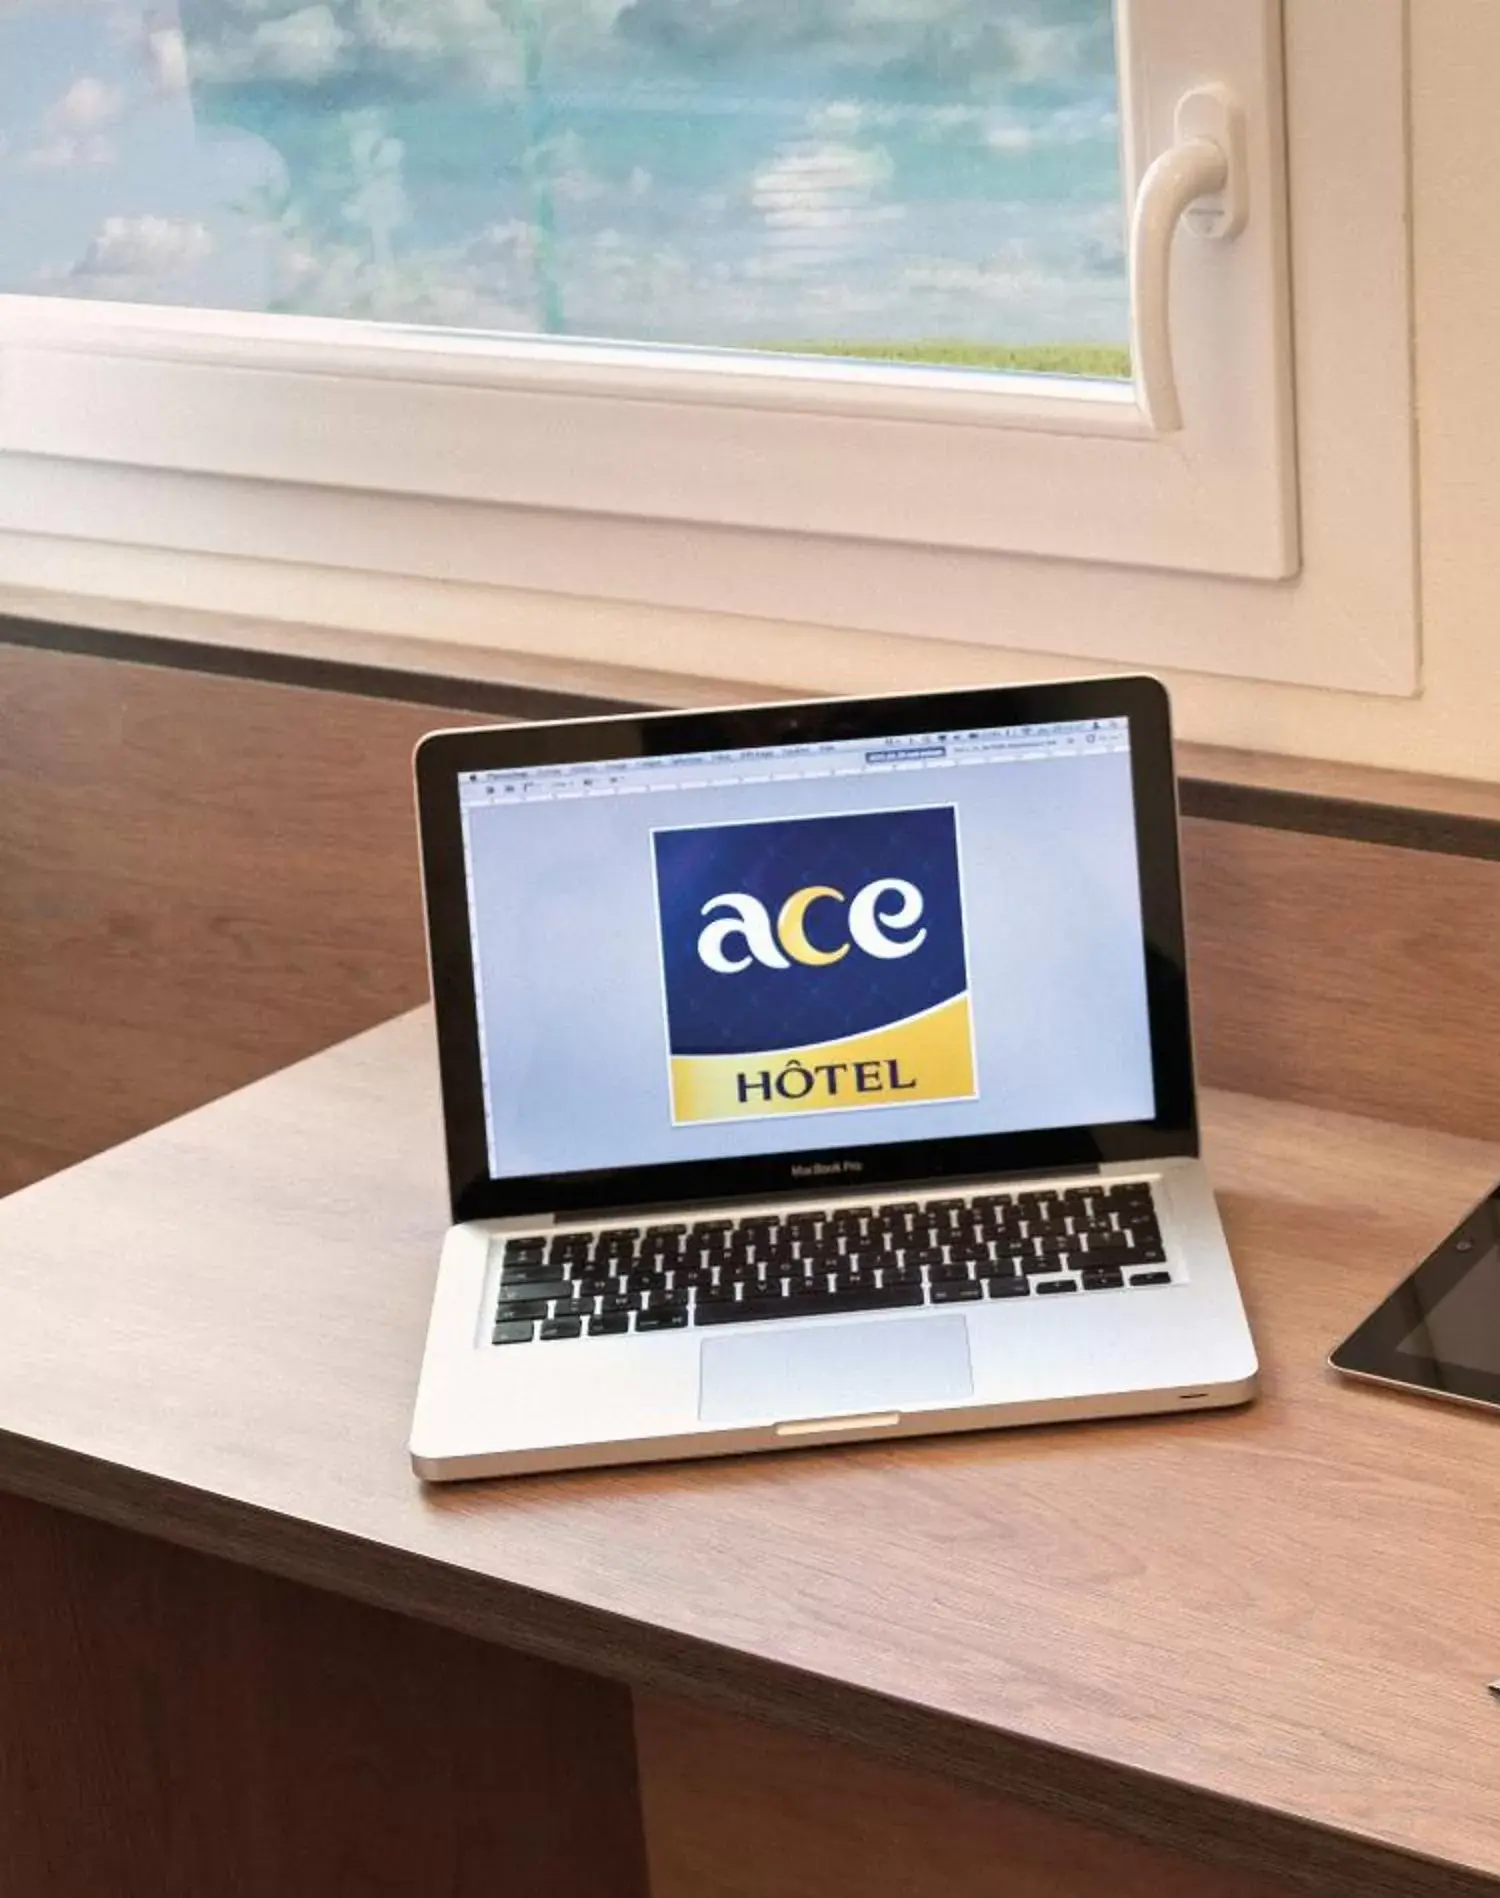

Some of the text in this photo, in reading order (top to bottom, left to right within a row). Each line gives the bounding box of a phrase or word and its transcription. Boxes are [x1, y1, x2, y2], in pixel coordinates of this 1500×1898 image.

[697, 877, 928, 974] ace
[736, 1058, 917, 1104] HÔTEL
[790, 1162, 841, 1177] MacBook
